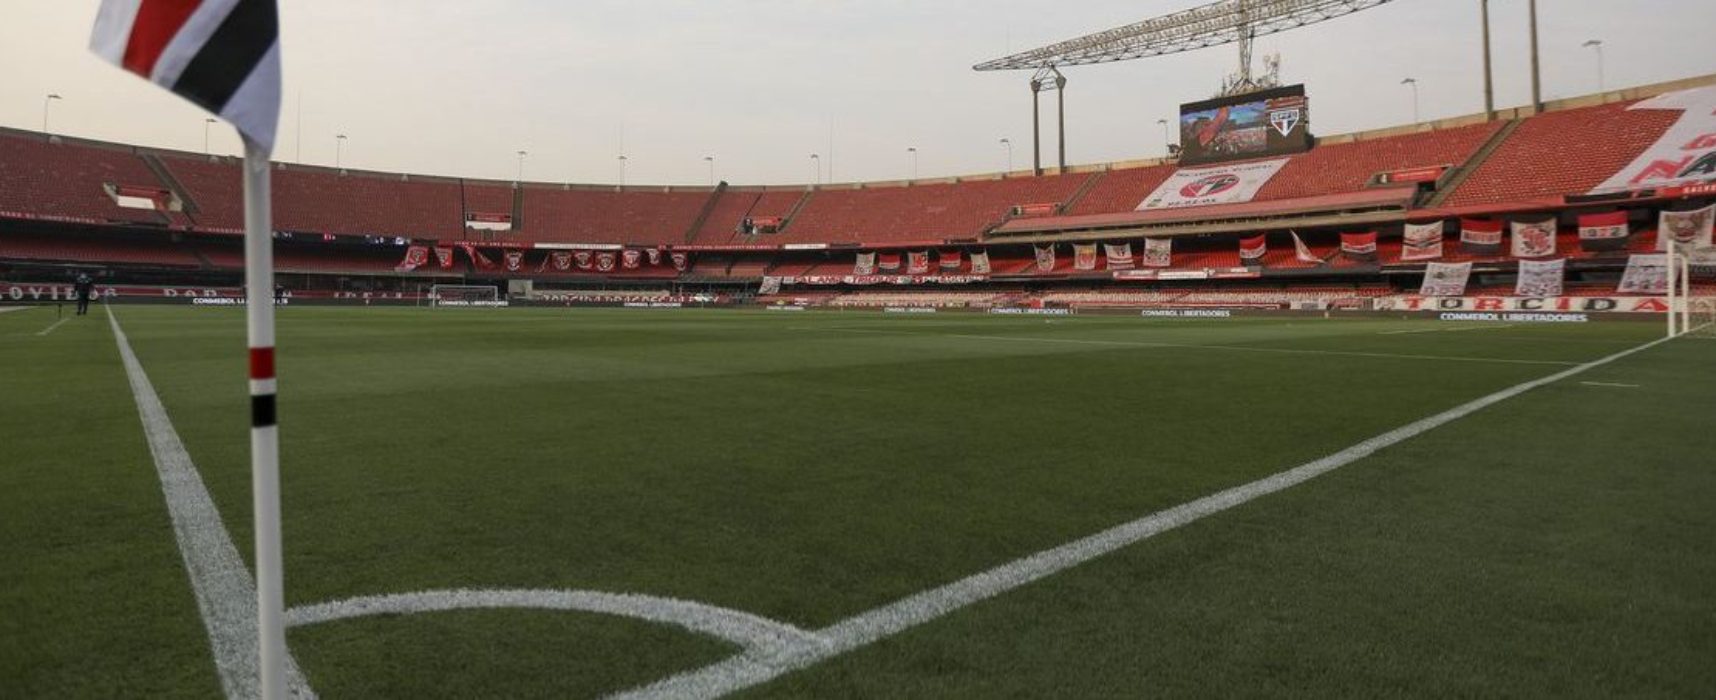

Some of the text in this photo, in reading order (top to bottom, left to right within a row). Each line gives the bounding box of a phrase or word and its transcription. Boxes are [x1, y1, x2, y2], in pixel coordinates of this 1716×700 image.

[1402, 295, 1669, 312] TORCIDA
[1142, 309, 1178, 317] CONMEBOL
[1440, 312, 1587, 323] CONMEBOL LIBERTADORES
